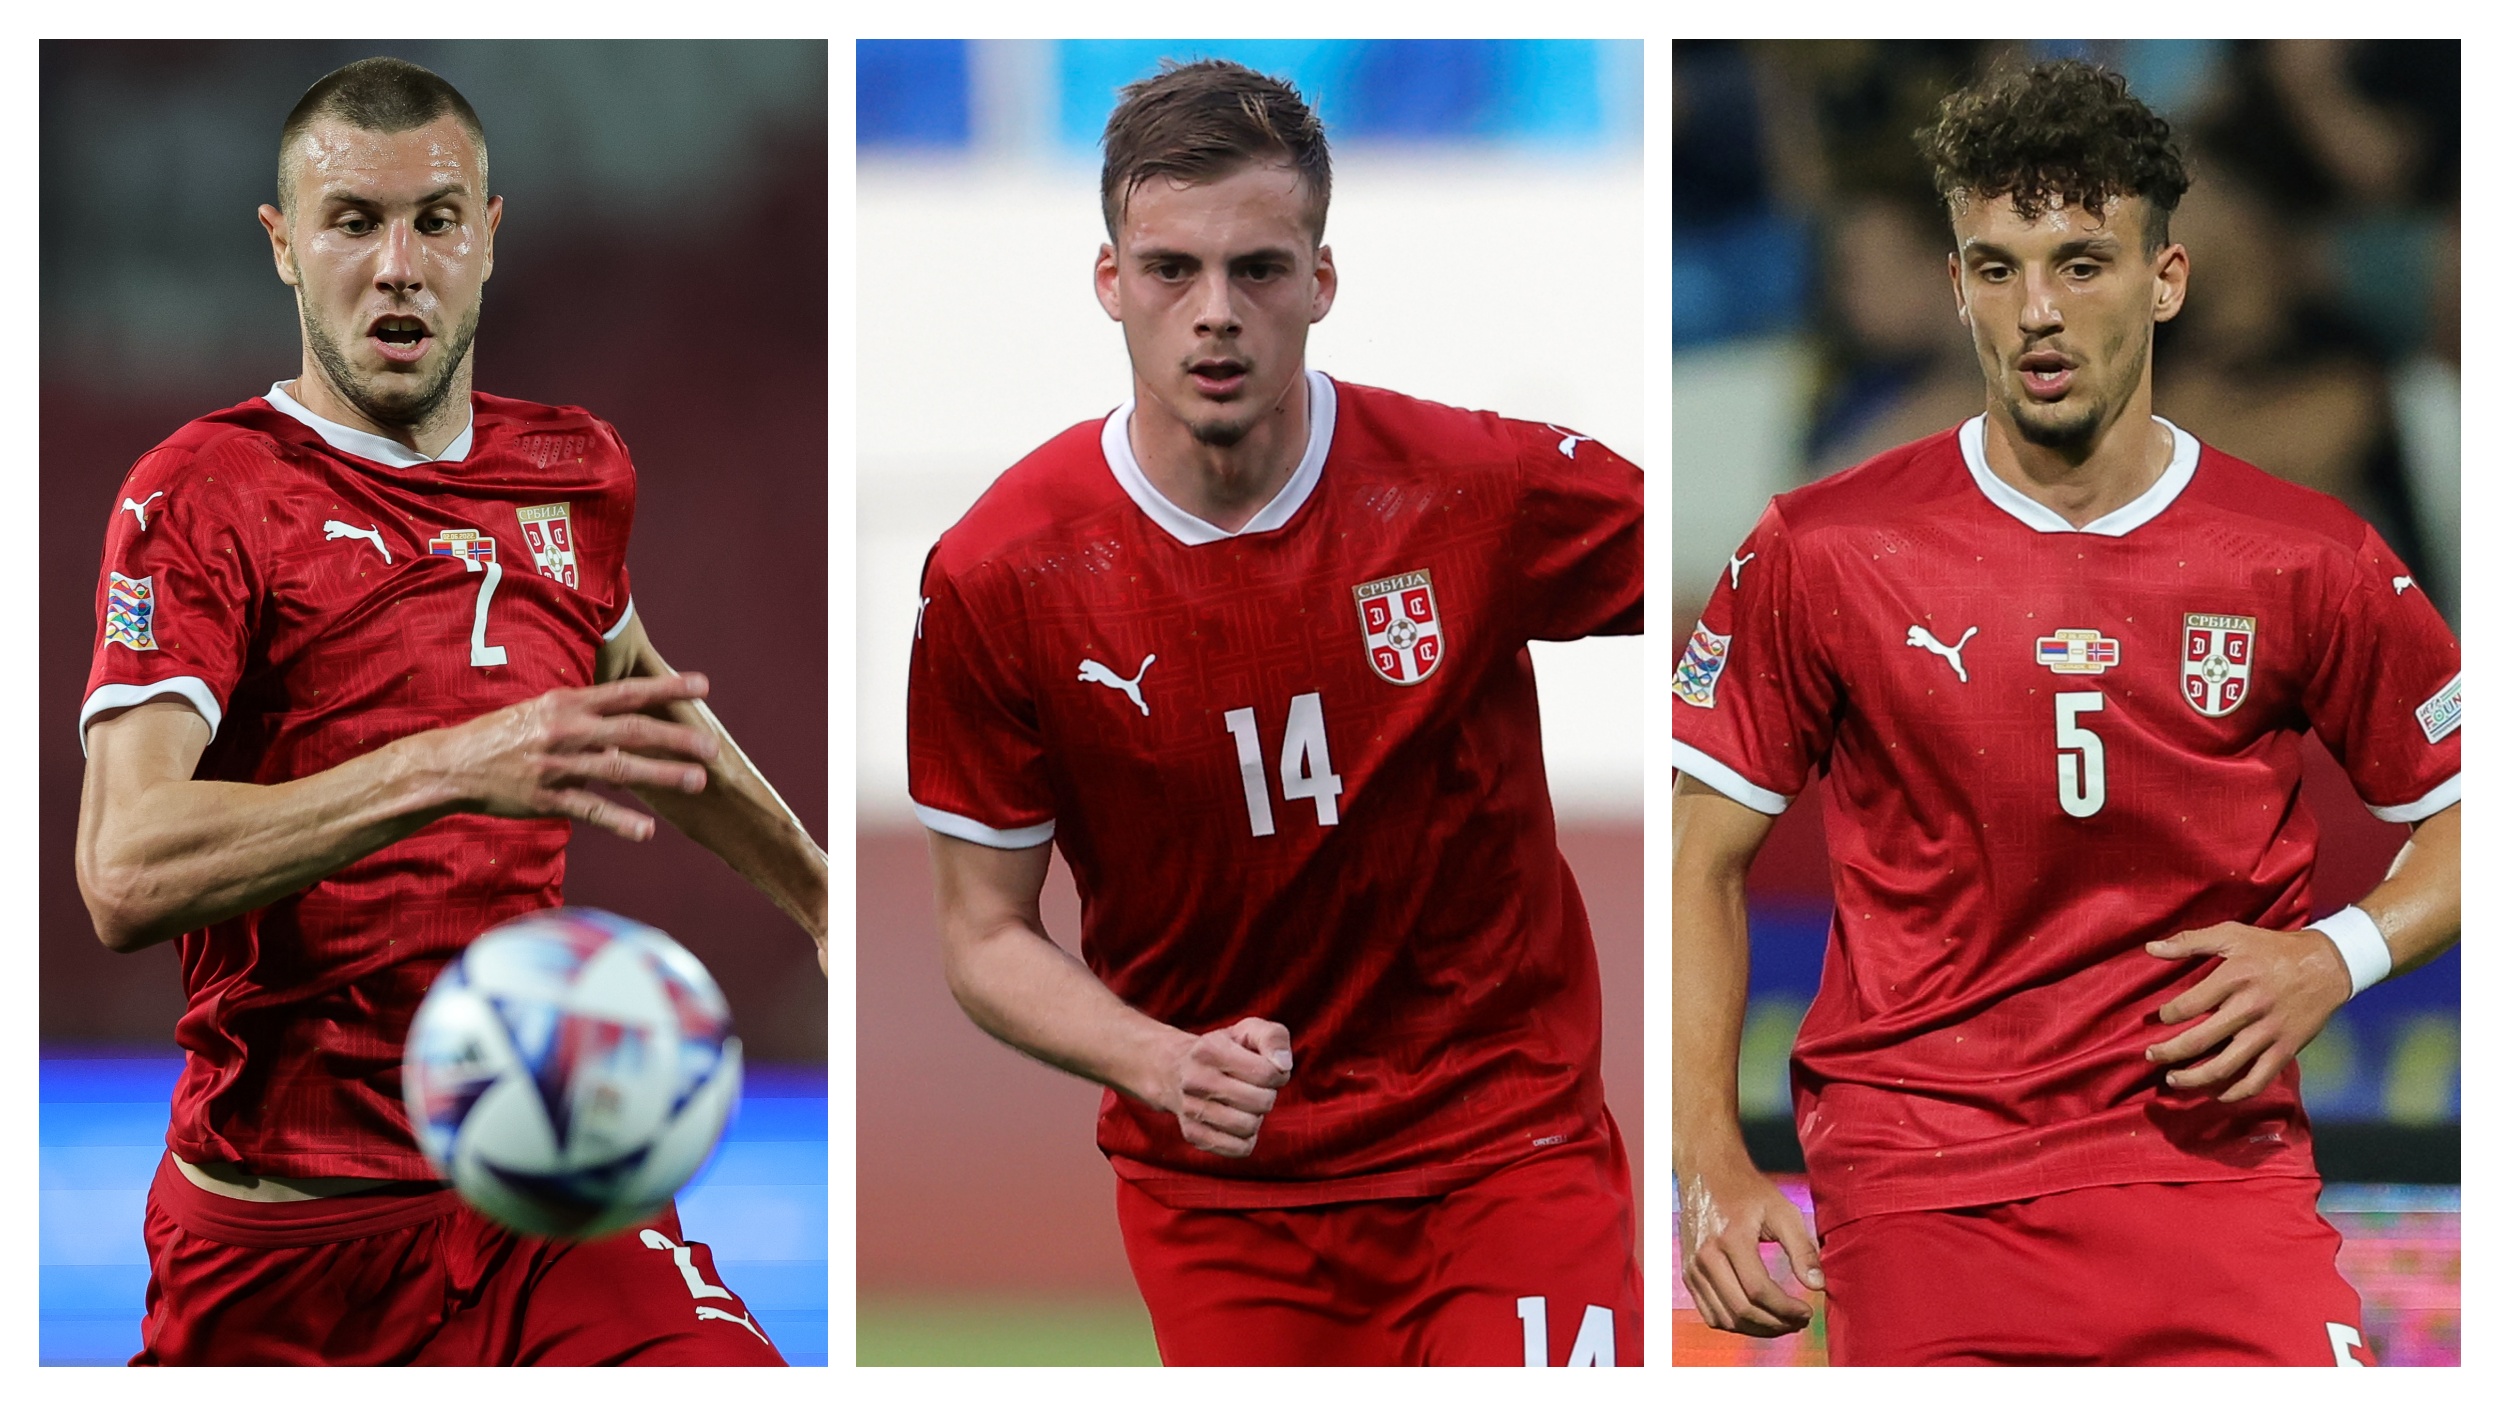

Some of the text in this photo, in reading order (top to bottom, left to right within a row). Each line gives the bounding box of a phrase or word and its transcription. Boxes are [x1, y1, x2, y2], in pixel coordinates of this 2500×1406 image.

[518, 504, 566, 520] СРБИЈА
[466, 560, 508, 667] 2
[1357, 573, 1426, 598] СРБИЈА
[2187, 614, 2251, 631] СРБИЈА
[1224, 692, 1343, 837] 14
[2055, 691, 2105, 818] 5
[639, 1228, 733, 1301] 2
